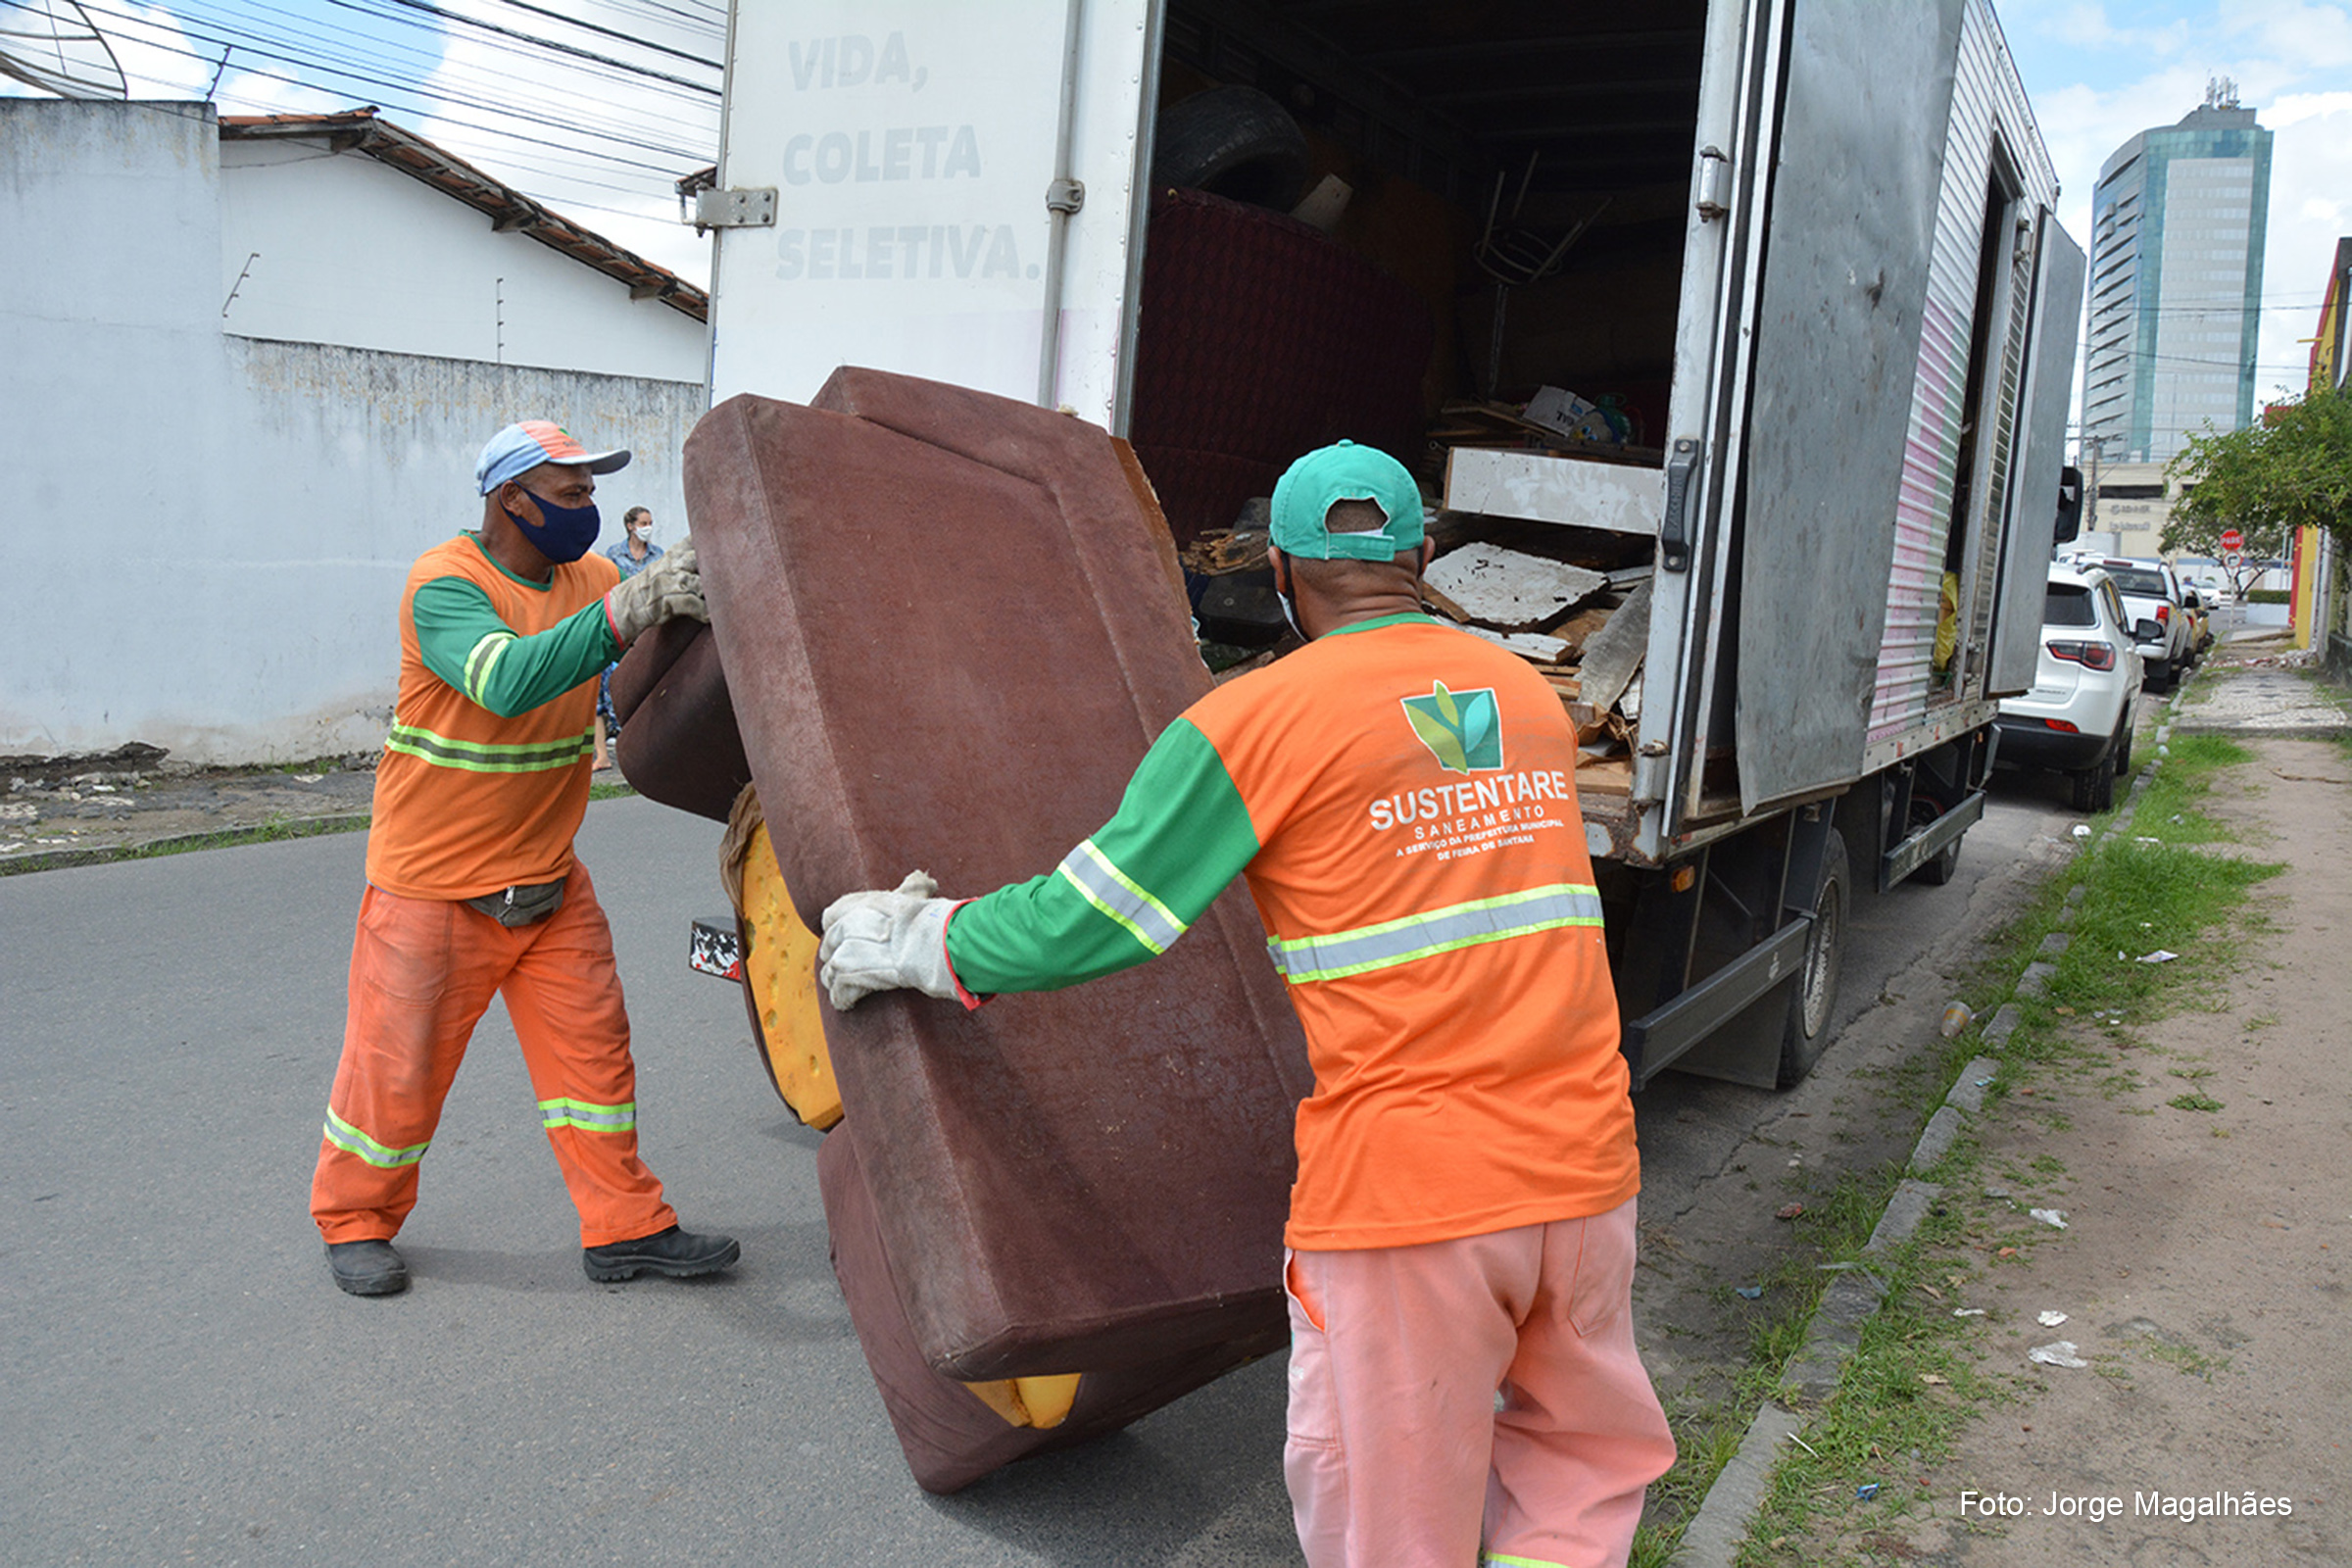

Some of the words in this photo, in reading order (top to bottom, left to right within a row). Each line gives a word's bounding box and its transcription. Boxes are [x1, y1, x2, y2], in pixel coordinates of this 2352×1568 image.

[788, 31, 929, 93] VIDA,
[782, 124, 982, 185] COLETA
[775, 223, 1041, 281] SELETIVA.
[1369, 770, 1570, 831] SUSTENTARE
[1414, 805, 1545, 841] SANEAMENTO
[1396, 848, 1404, 858] A
[1405, 839, 1447, 856] SERVIÇO
[1448, 836, 1462, 847] DA
[1463, 824, 1519, 844] PREFEITURA
[1520, 819, 1564, 832] MUNICIPAL
[1437, 852, 1450, 861] DE
[1451, 845, 1480, 858] FEIRA
[1482, 841, 1496, 852] DE
[1497, 834, 1535, 848] SANTANA
